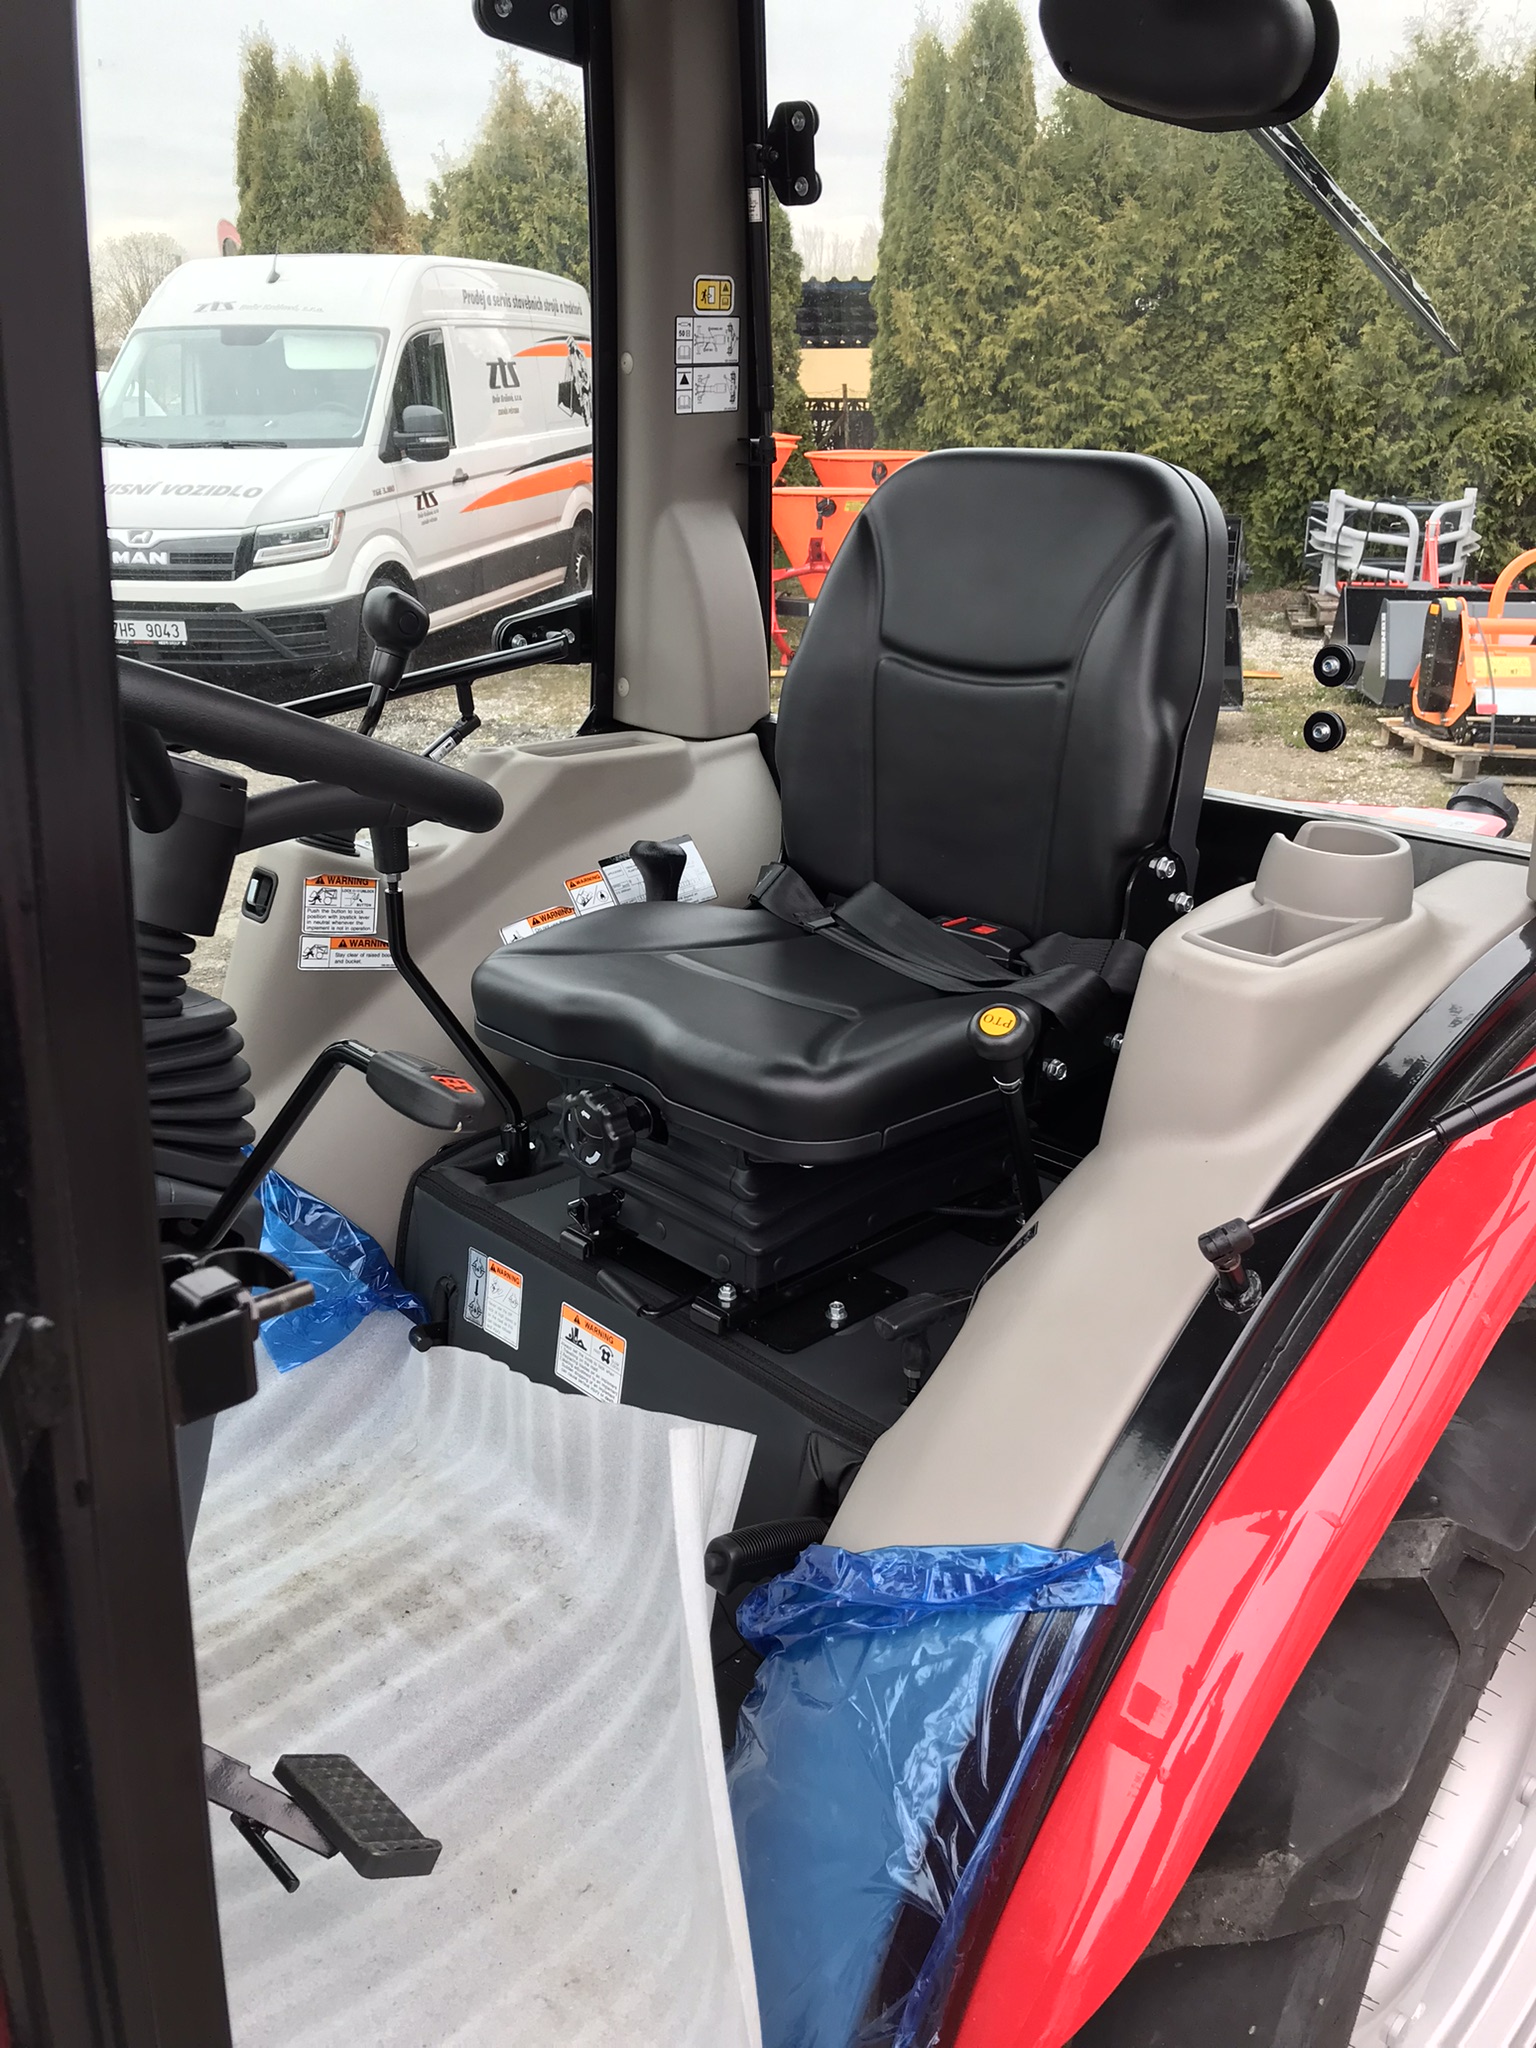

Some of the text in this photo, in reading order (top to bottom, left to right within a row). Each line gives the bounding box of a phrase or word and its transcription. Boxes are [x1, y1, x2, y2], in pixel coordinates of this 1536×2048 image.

[462, 289, 486, 310] Prodej
[487, 295, 492, 306] a
[493, 293, 511, 307] servis
[160, 484, 263, 499] VOZIDLO
[112, 551, 168, 565] MAN
[146, 623, 180, 638] 9043
[327, 875, 369, 886] WARNING
[576, 874, 601, 885] WARNING
[539, 906, 573, 922] WARNING
[350, 939, 389, 948] WARNIN
[984, 1014, 1013, 1028] PTO
[496, 1267, 520, 1285] WARNING
[585, 1322, 614, 1344] WARNING
